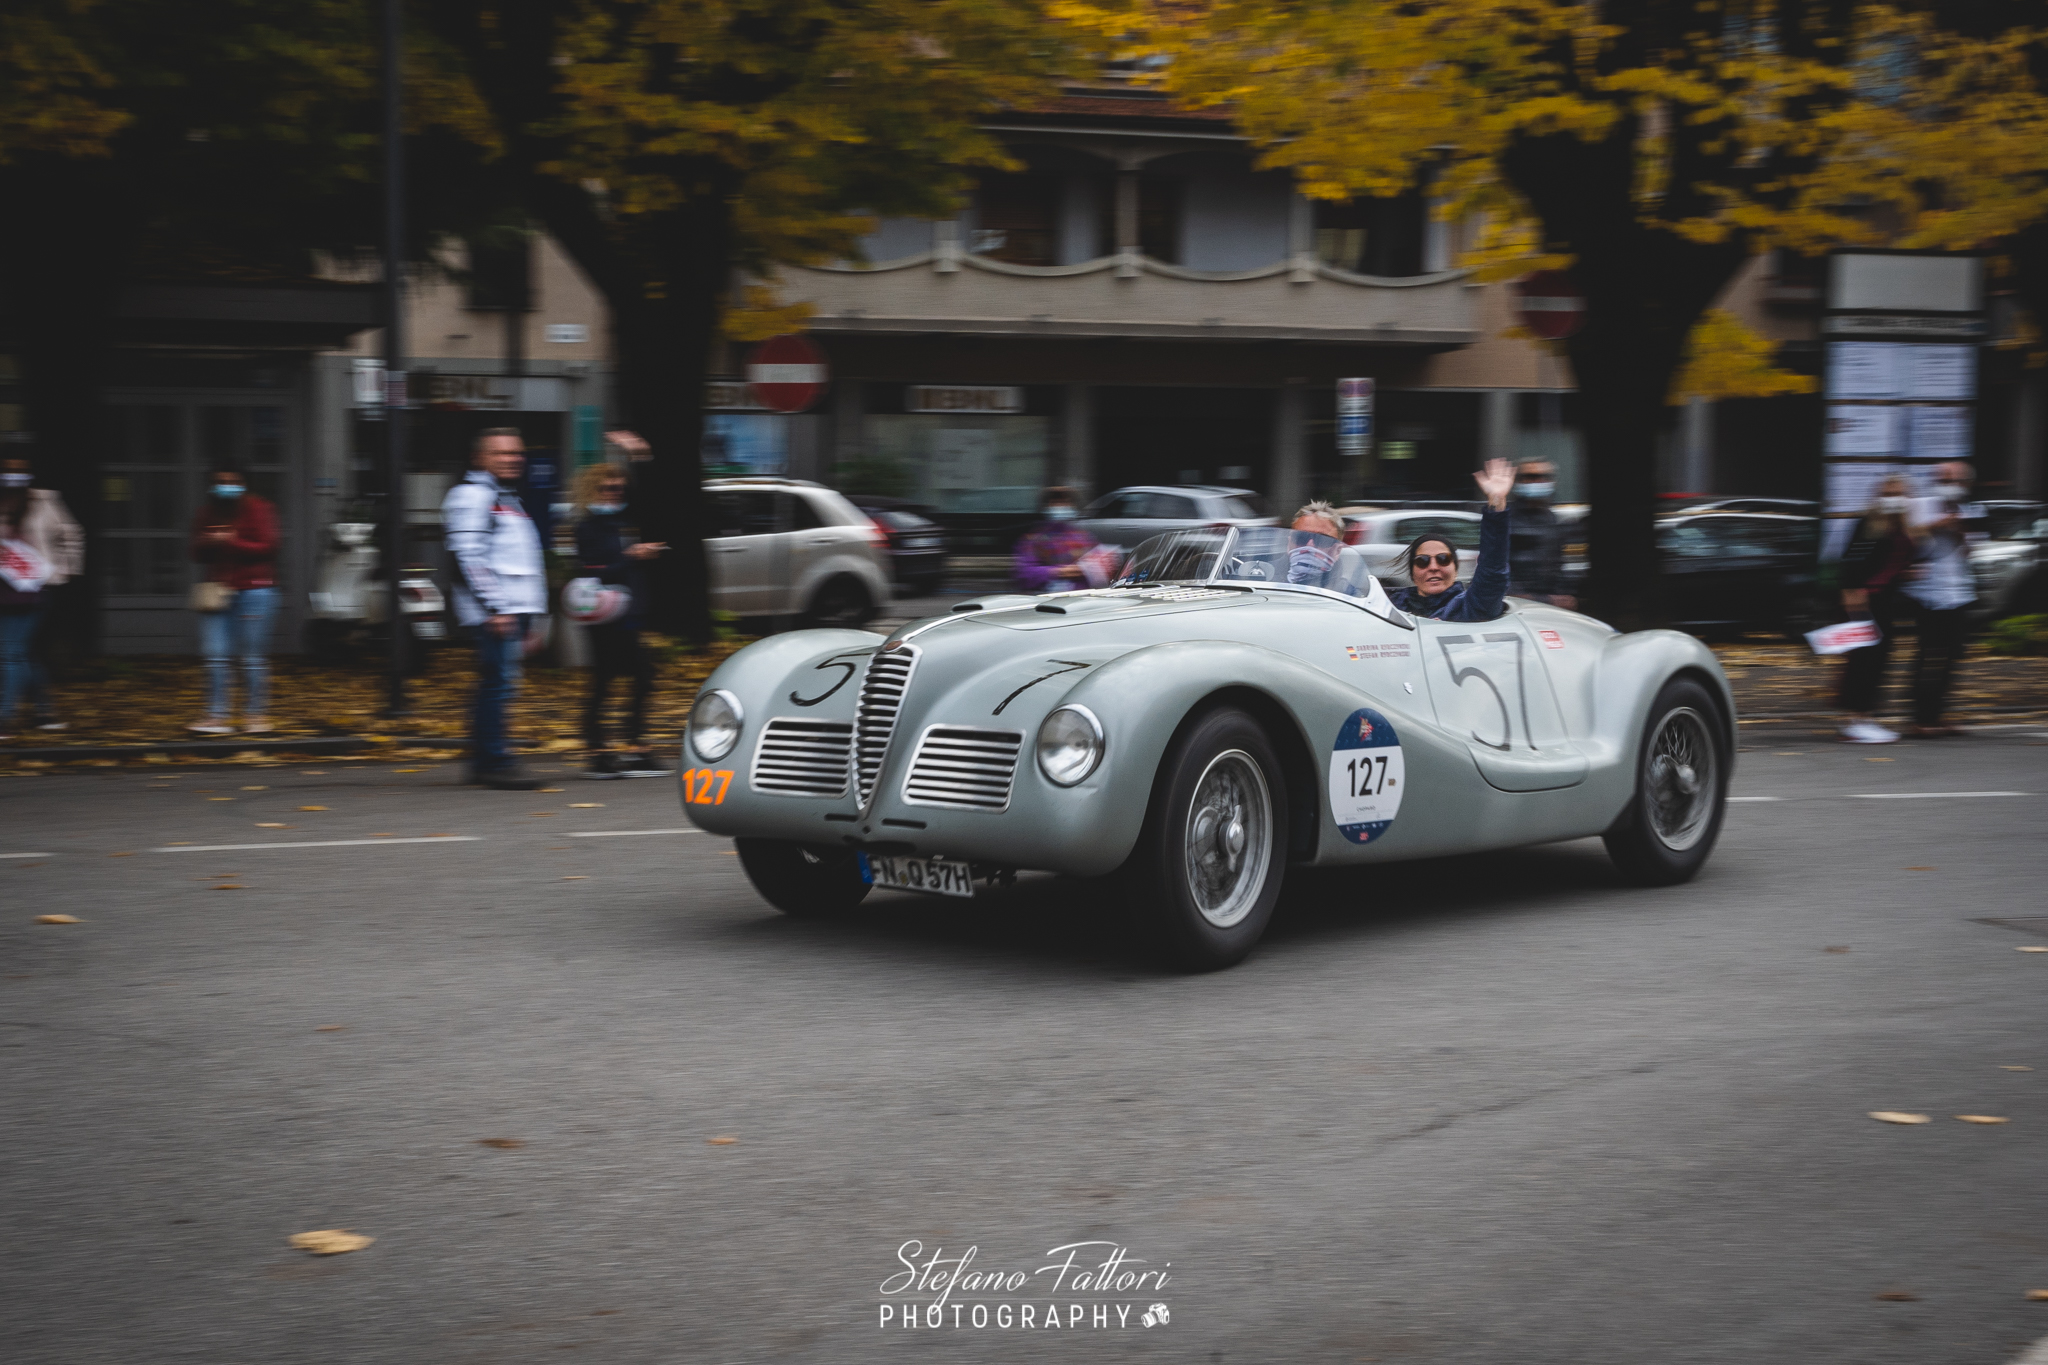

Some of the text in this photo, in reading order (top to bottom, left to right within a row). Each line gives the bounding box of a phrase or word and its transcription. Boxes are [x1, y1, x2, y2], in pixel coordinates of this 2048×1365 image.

[790, 652, 1092, 716] 5 7
[1436, 632, 1538, 752] 57
[682, 768, 735, 806] 127
[1347, 756, 1388, 798] 127
